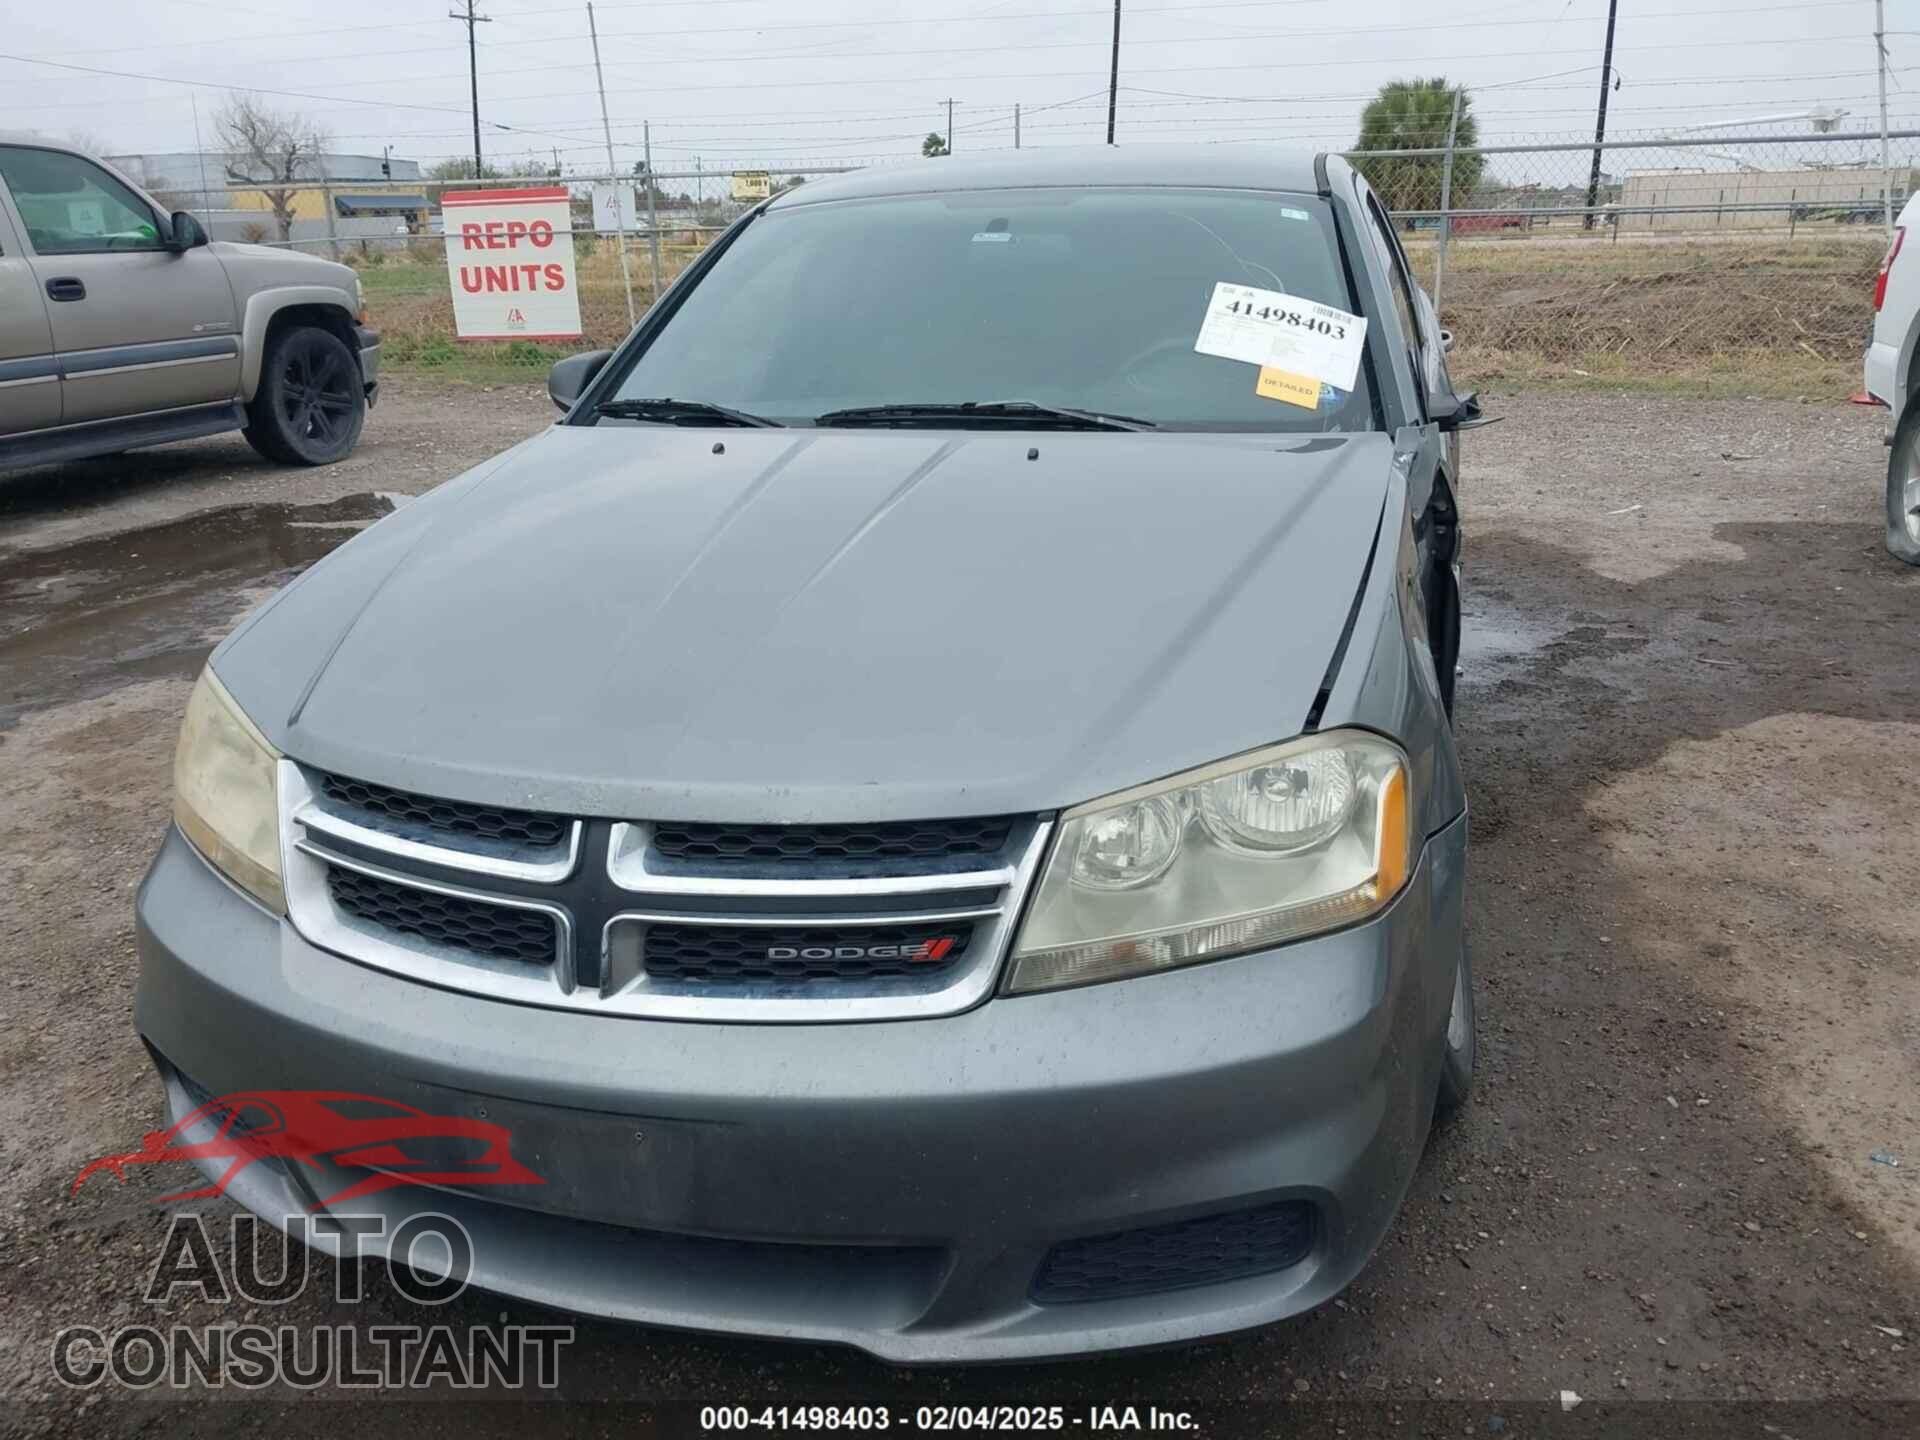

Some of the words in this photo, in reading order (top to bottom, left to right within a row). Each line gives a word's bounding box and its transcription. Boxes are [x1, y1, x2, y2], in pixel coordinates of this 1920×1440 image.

[462, 219, 554, 250] REPO
[459, 263, 566, 294] UNITS
[1225, 300, 1345, 340] 41498403
[1264, 378, 1313, 395] DETAILED
[767, 944, 930, 960] DODGE
